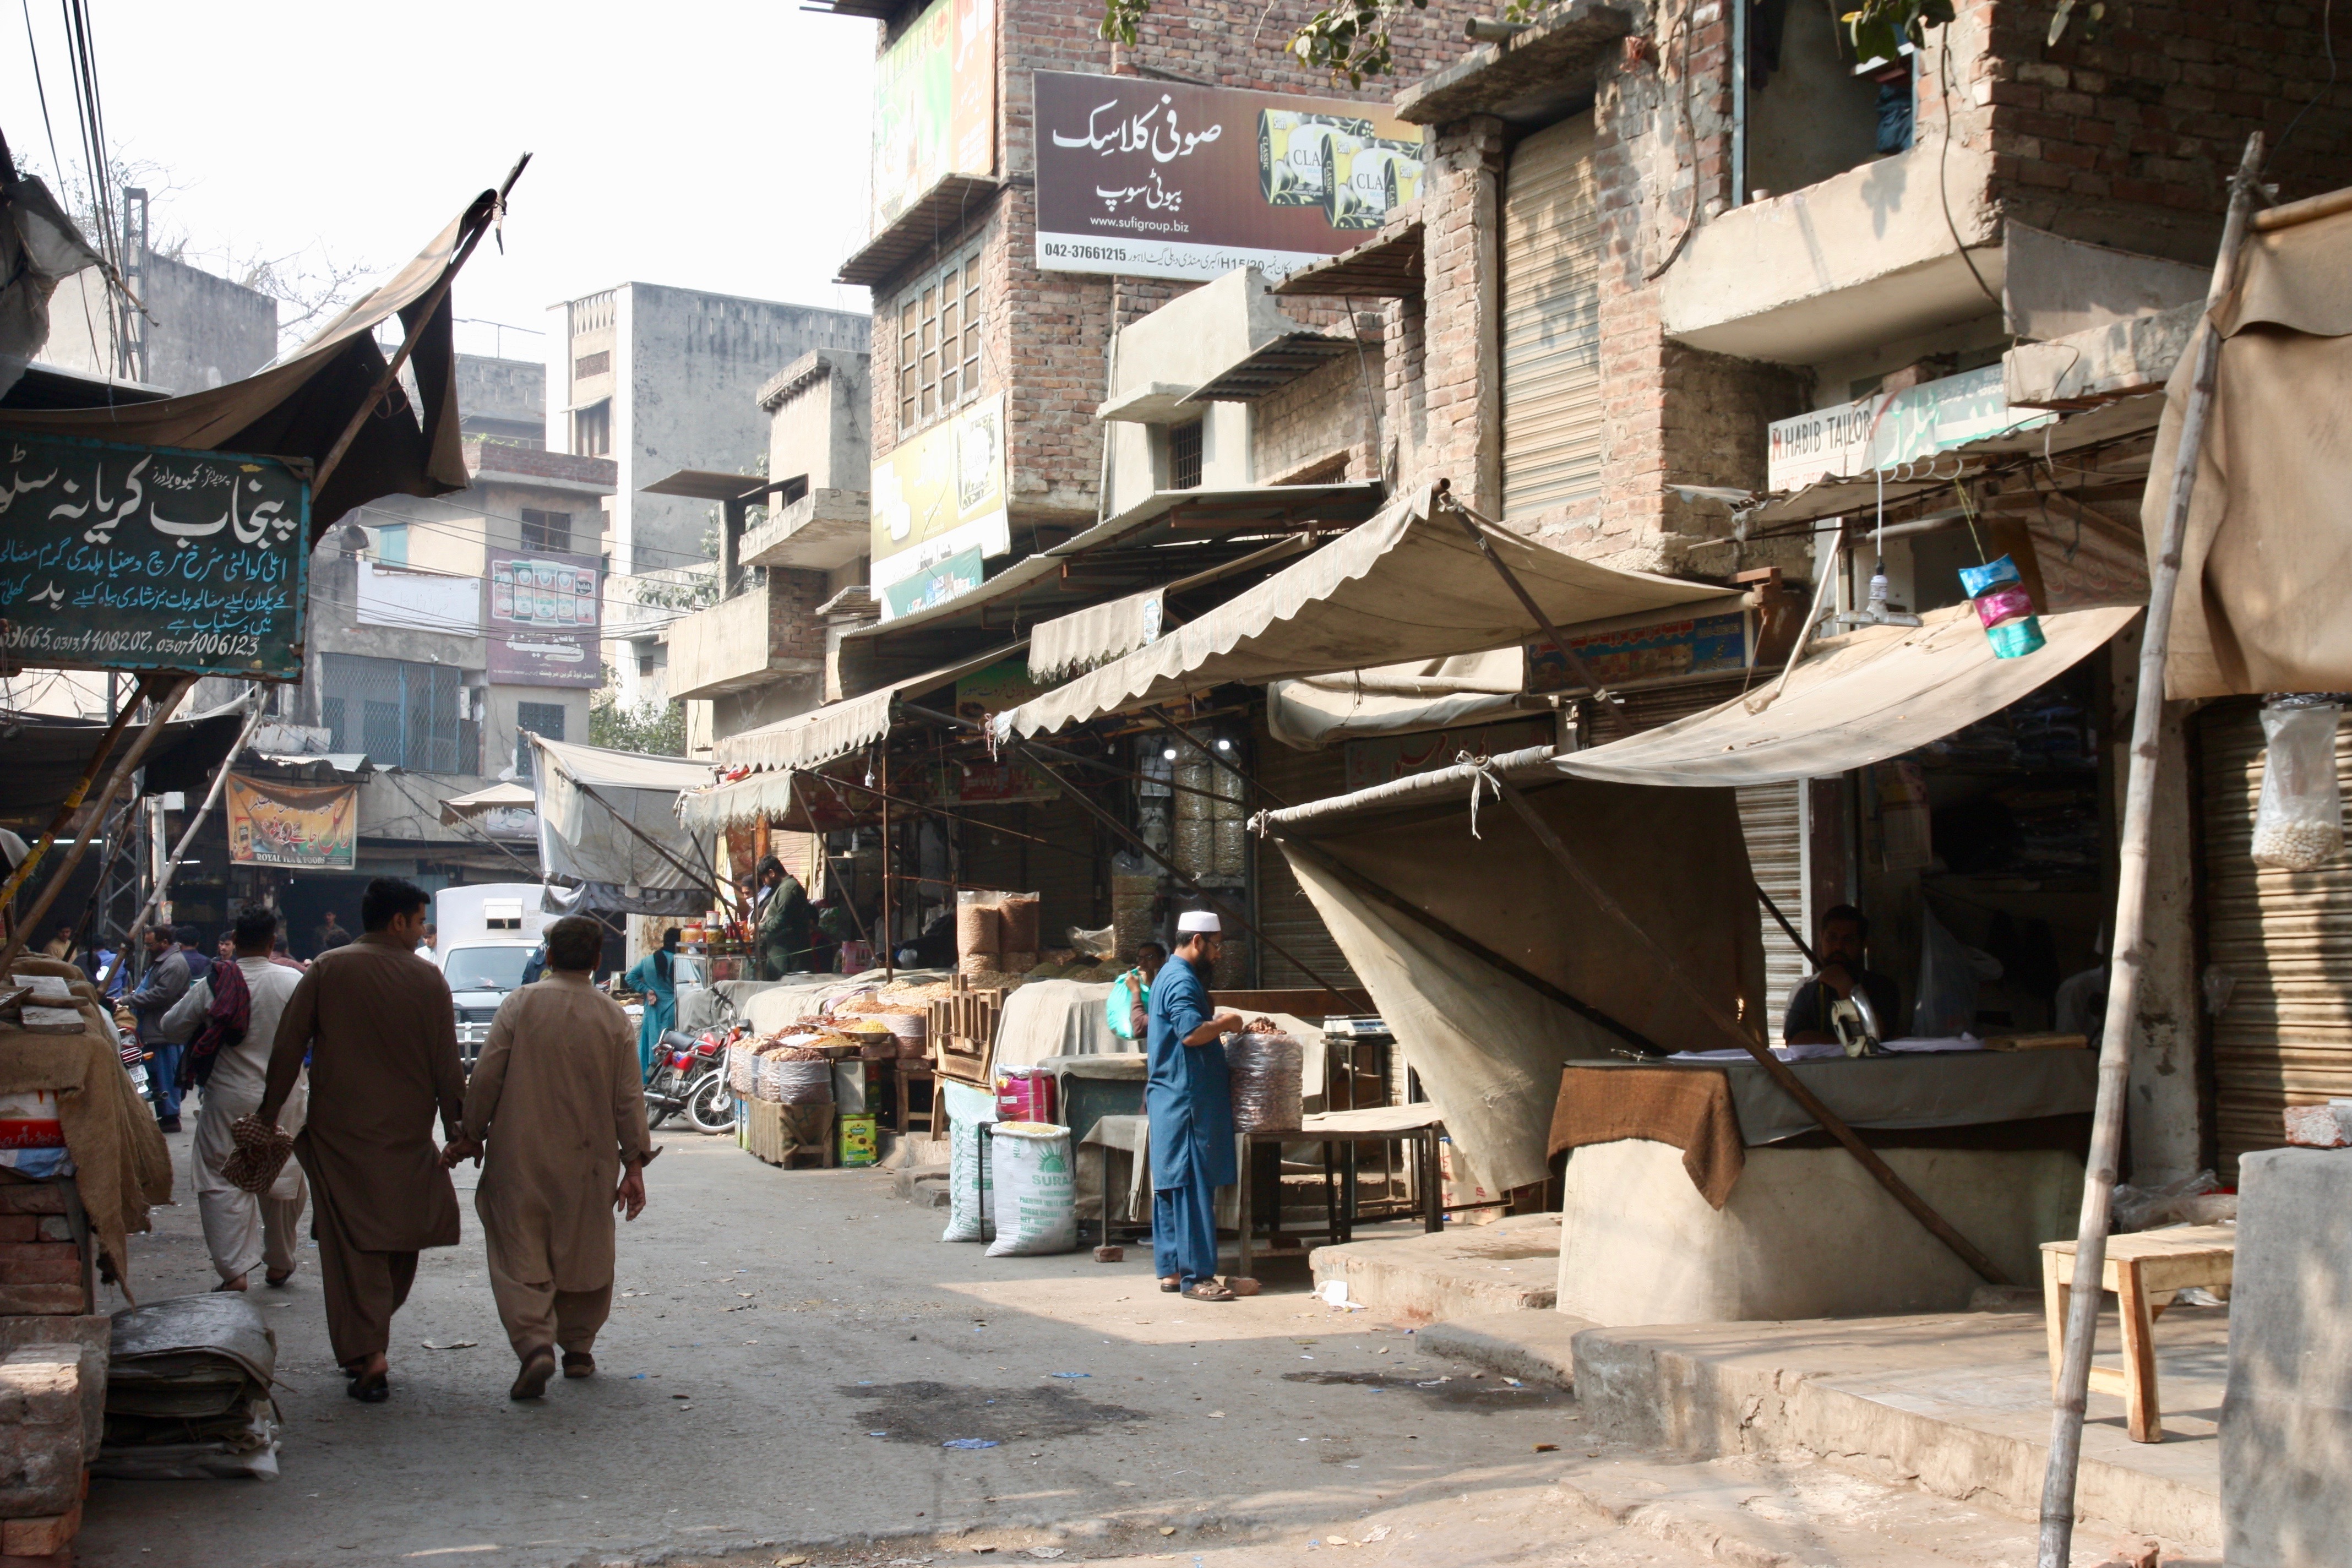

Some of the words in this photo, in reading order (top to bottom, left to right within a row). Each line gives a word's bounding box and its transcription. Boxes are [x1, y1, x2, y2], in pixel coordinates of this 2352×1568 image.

[1152, 94, 1222, 163] صوفی
[1096, 184, 1148, 213] سوپ
[1146, 167, 1182, 212] بیوٹی
[1090, 216, 1190, 233] www.sufigroup.biz
[1045, 242, 1126, 262] 042-37661215
[1128, 251, 1147, 262] لاہور
[1201, 251, 1223, 270] اکبری
[1264, 255, 1277, 274] نمبر
[1275, 260, 1293, 275] دکان
[175, 462, 203, 491] کمبوہ
[48, 454, 153, 545] کریانہ
[150, 475, 298, 549] پنجاب
[39, 537, 72, 570] گرم
[223, 549, 268, 582] کوالٹی
[165, 588, 192, 611] جات
[244, 584, 278, 615] پکوان
[193, 611, 249, 634] دستیاب
[250, 617, 271, 635] میں
[257, 853, 282, 862] ROYAL
[303, 856, 326, 864] FOODS
